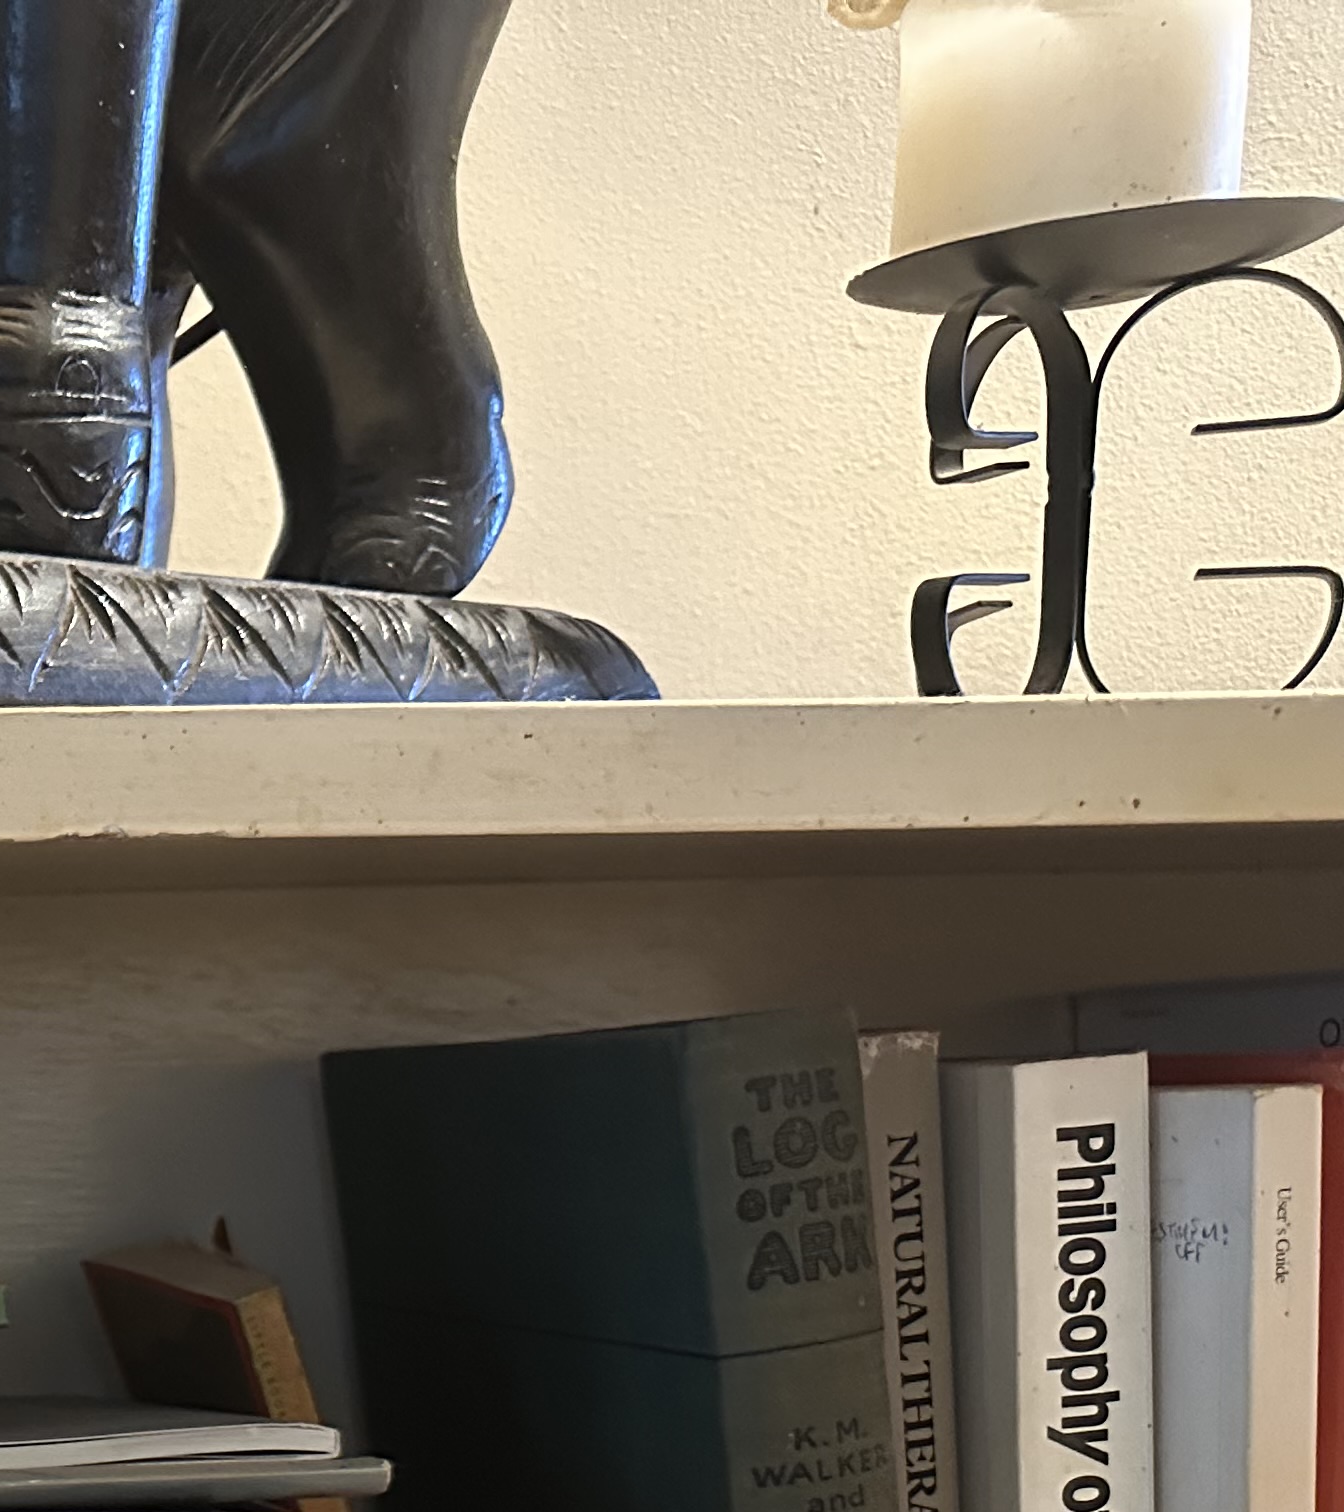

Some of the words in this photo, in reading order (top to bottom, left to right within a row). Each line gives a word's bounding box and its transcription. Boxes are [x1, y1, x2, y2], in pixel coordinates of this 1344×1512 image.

[744, 1066, 841, 1114] THE
[735, 1182, 801, 1222] OF
[801, 1168, 868, 1213] THE
[1274, 1185, 1294, 1241] User's
[885, 1131, 930, 1362] NATURAL
[1274, 1242, 1291, 1285] Guide
[1045, 1121, 1122, 1468] Philosophy
